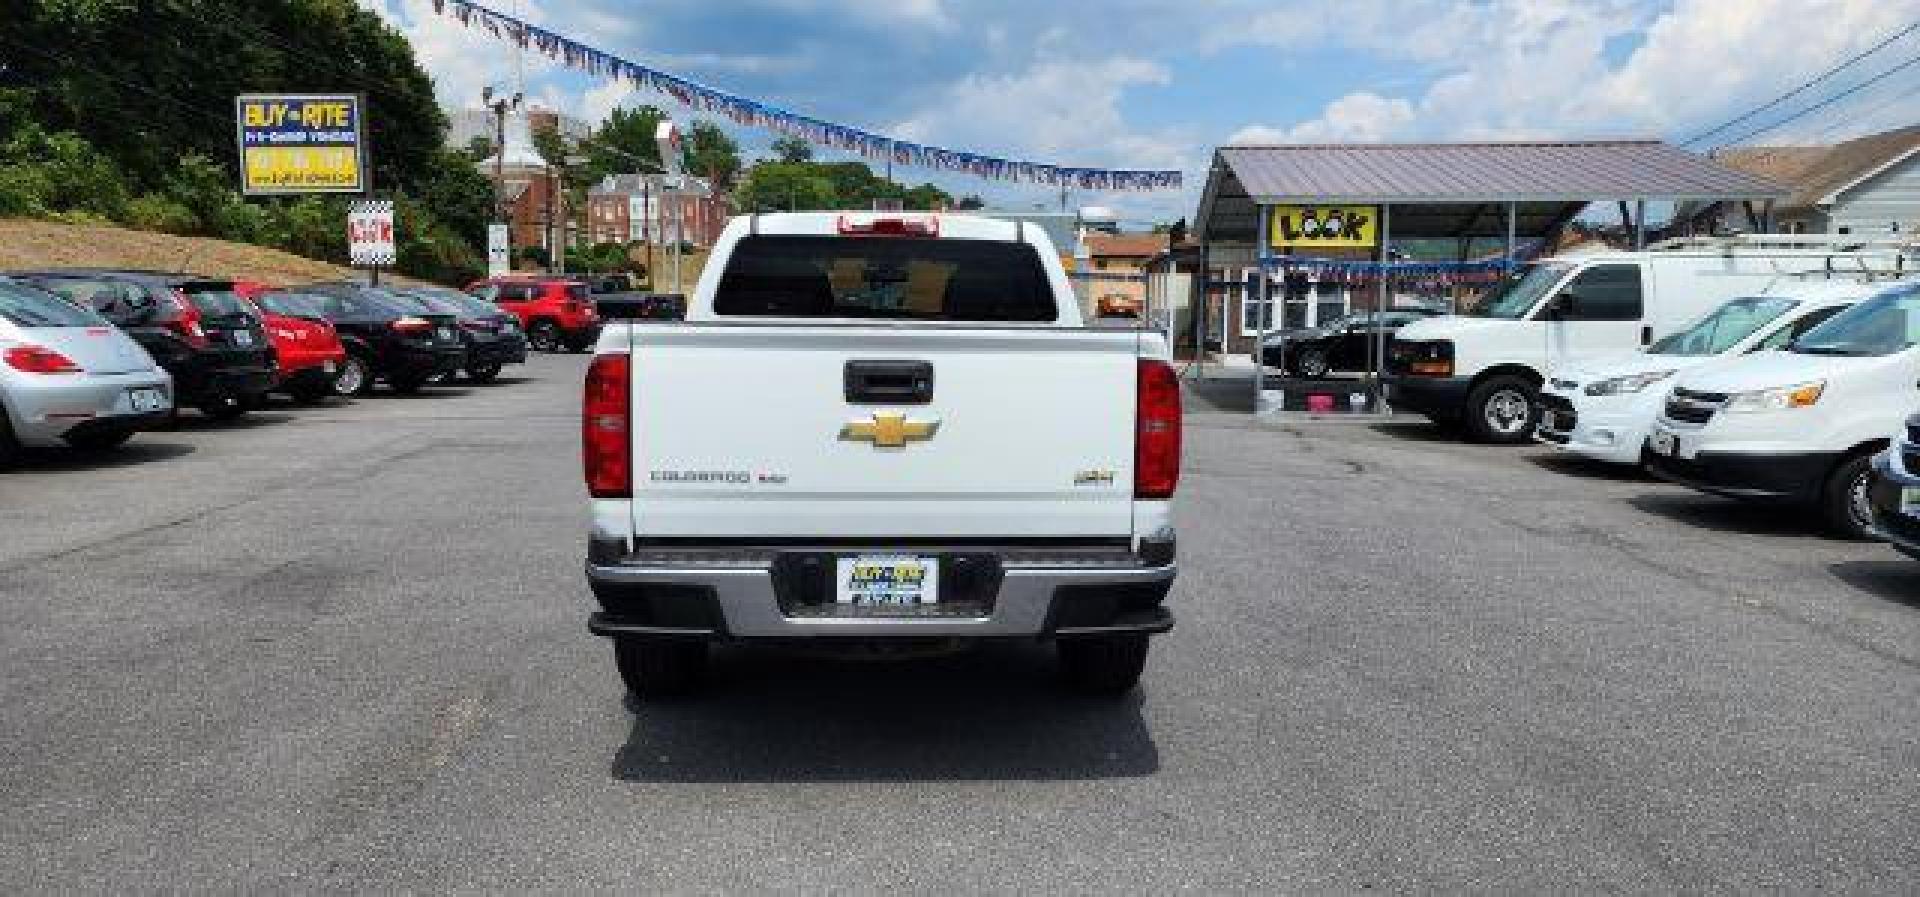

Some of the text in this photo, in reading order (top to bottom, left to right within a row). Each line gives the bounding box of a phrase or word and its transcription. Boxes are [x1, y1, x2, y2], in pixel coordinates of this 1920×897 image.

[245, 103, 349, 127] BUY RITE
[1280, 209, 1369, 241] LOOK
[650, 470, 751, 483] COLORADO
